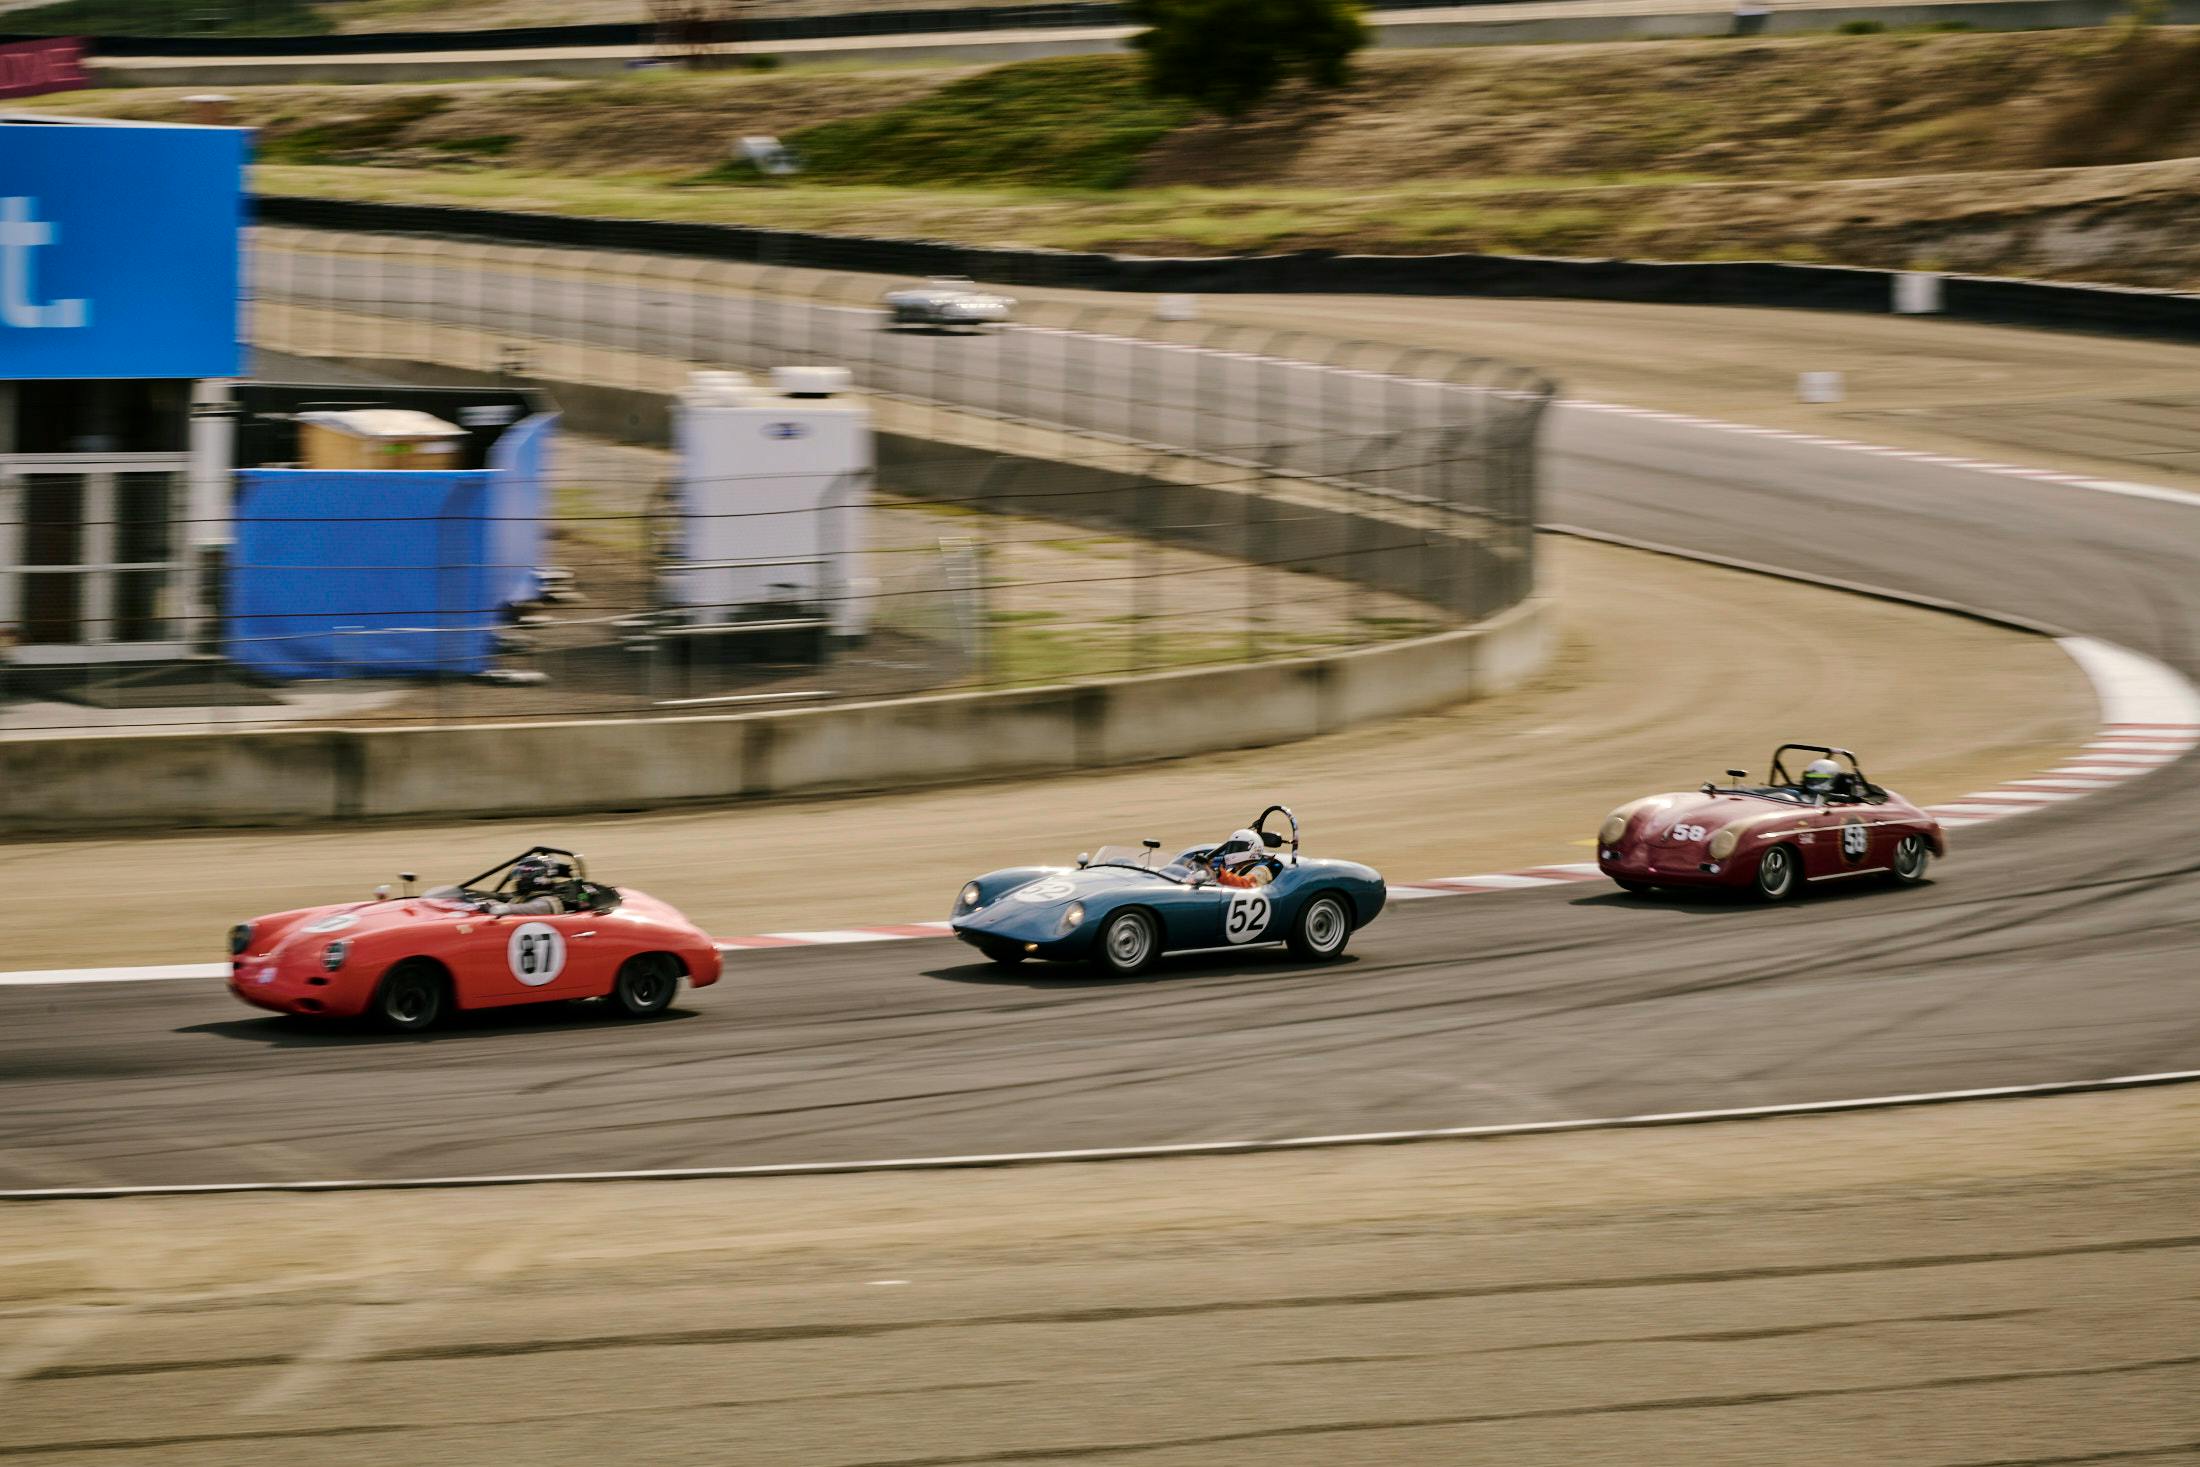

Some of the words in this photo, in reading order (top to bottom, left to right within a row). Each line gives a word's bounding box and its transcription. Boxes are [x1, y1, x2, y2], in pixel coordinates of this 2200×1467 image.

[1672, 824, 1706, 841] 58
[1844, 825, 1866, 854] 58
[1230, 898, 1266, 933] 52
[520, 934, 553, 974] 87
